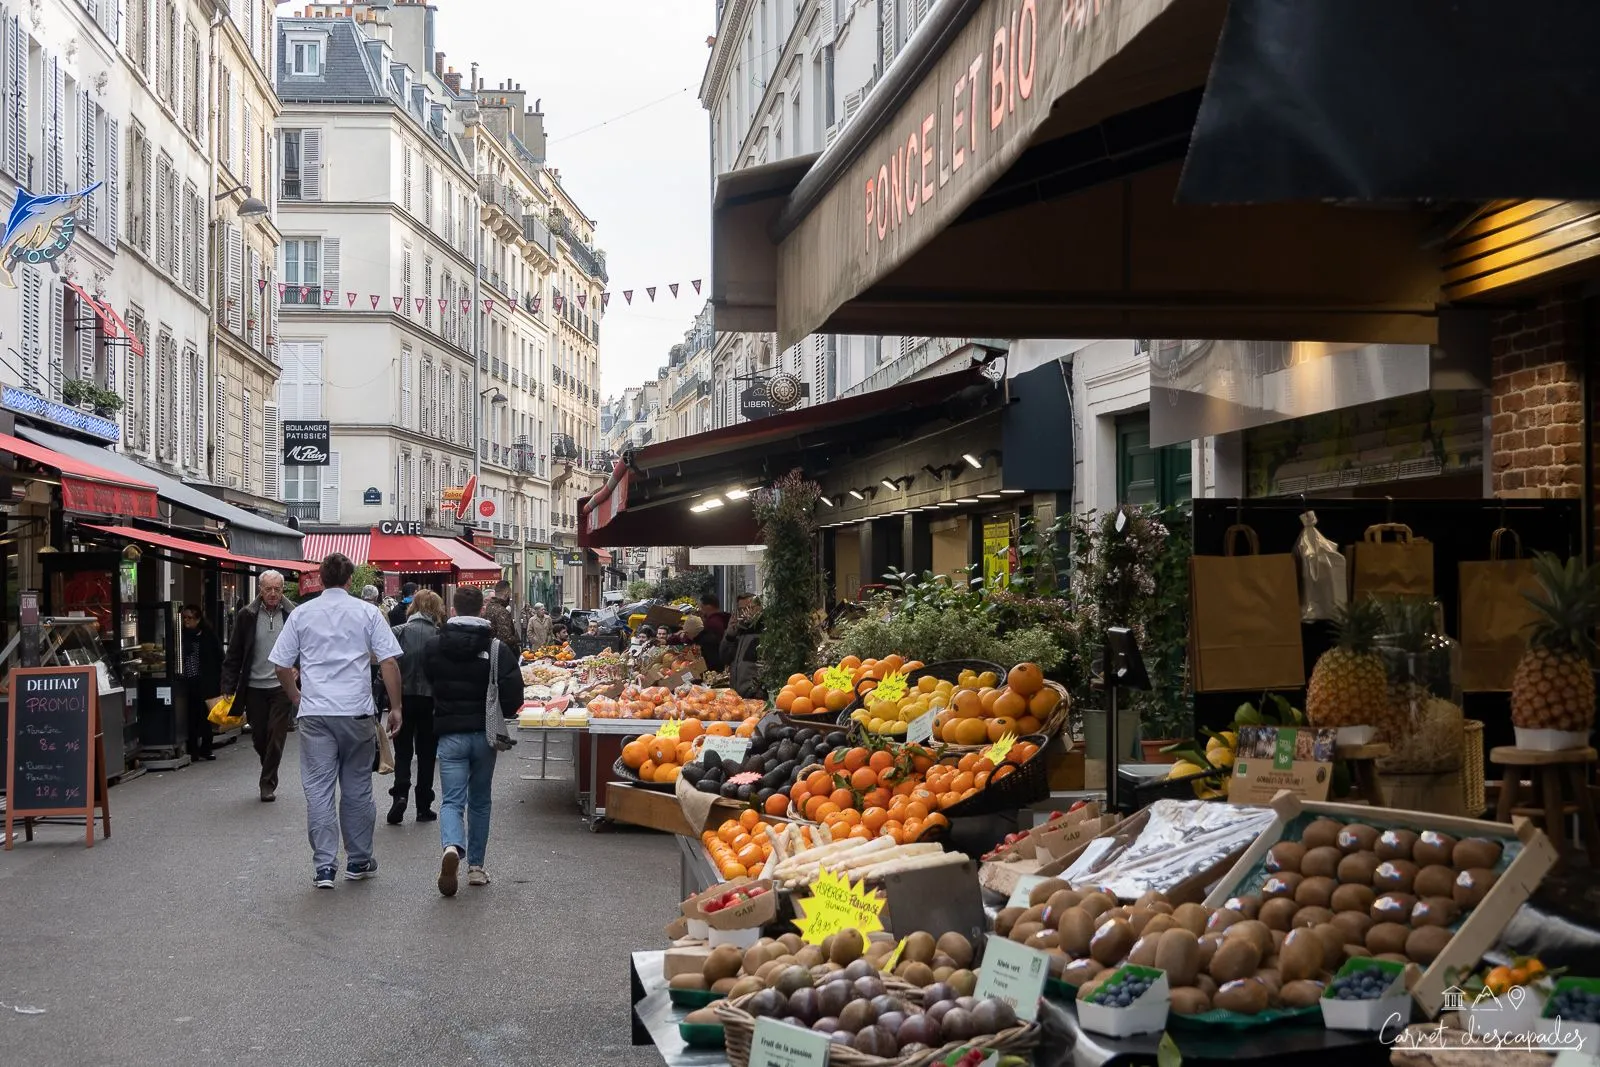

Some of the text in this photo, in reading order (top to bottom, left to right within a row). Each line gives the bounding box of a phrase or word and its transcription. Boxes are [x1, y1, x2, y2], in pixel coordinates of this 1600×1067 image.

[865, 0, 1037, 255] PONCELET BIO
[744, 400, 775, 408] LIBERT
[381, 519, 421, 535] CAFÉ
[27, 678, 80, 692] DELITALY
[25, 695, 85, 713] PROMO!
[760, 1037, 775, 1048] Fruit
[775, 1042, 782, 1051] de
[783, 1044, 789, 1053] la
[789, 1047, 812, 1059] passion
